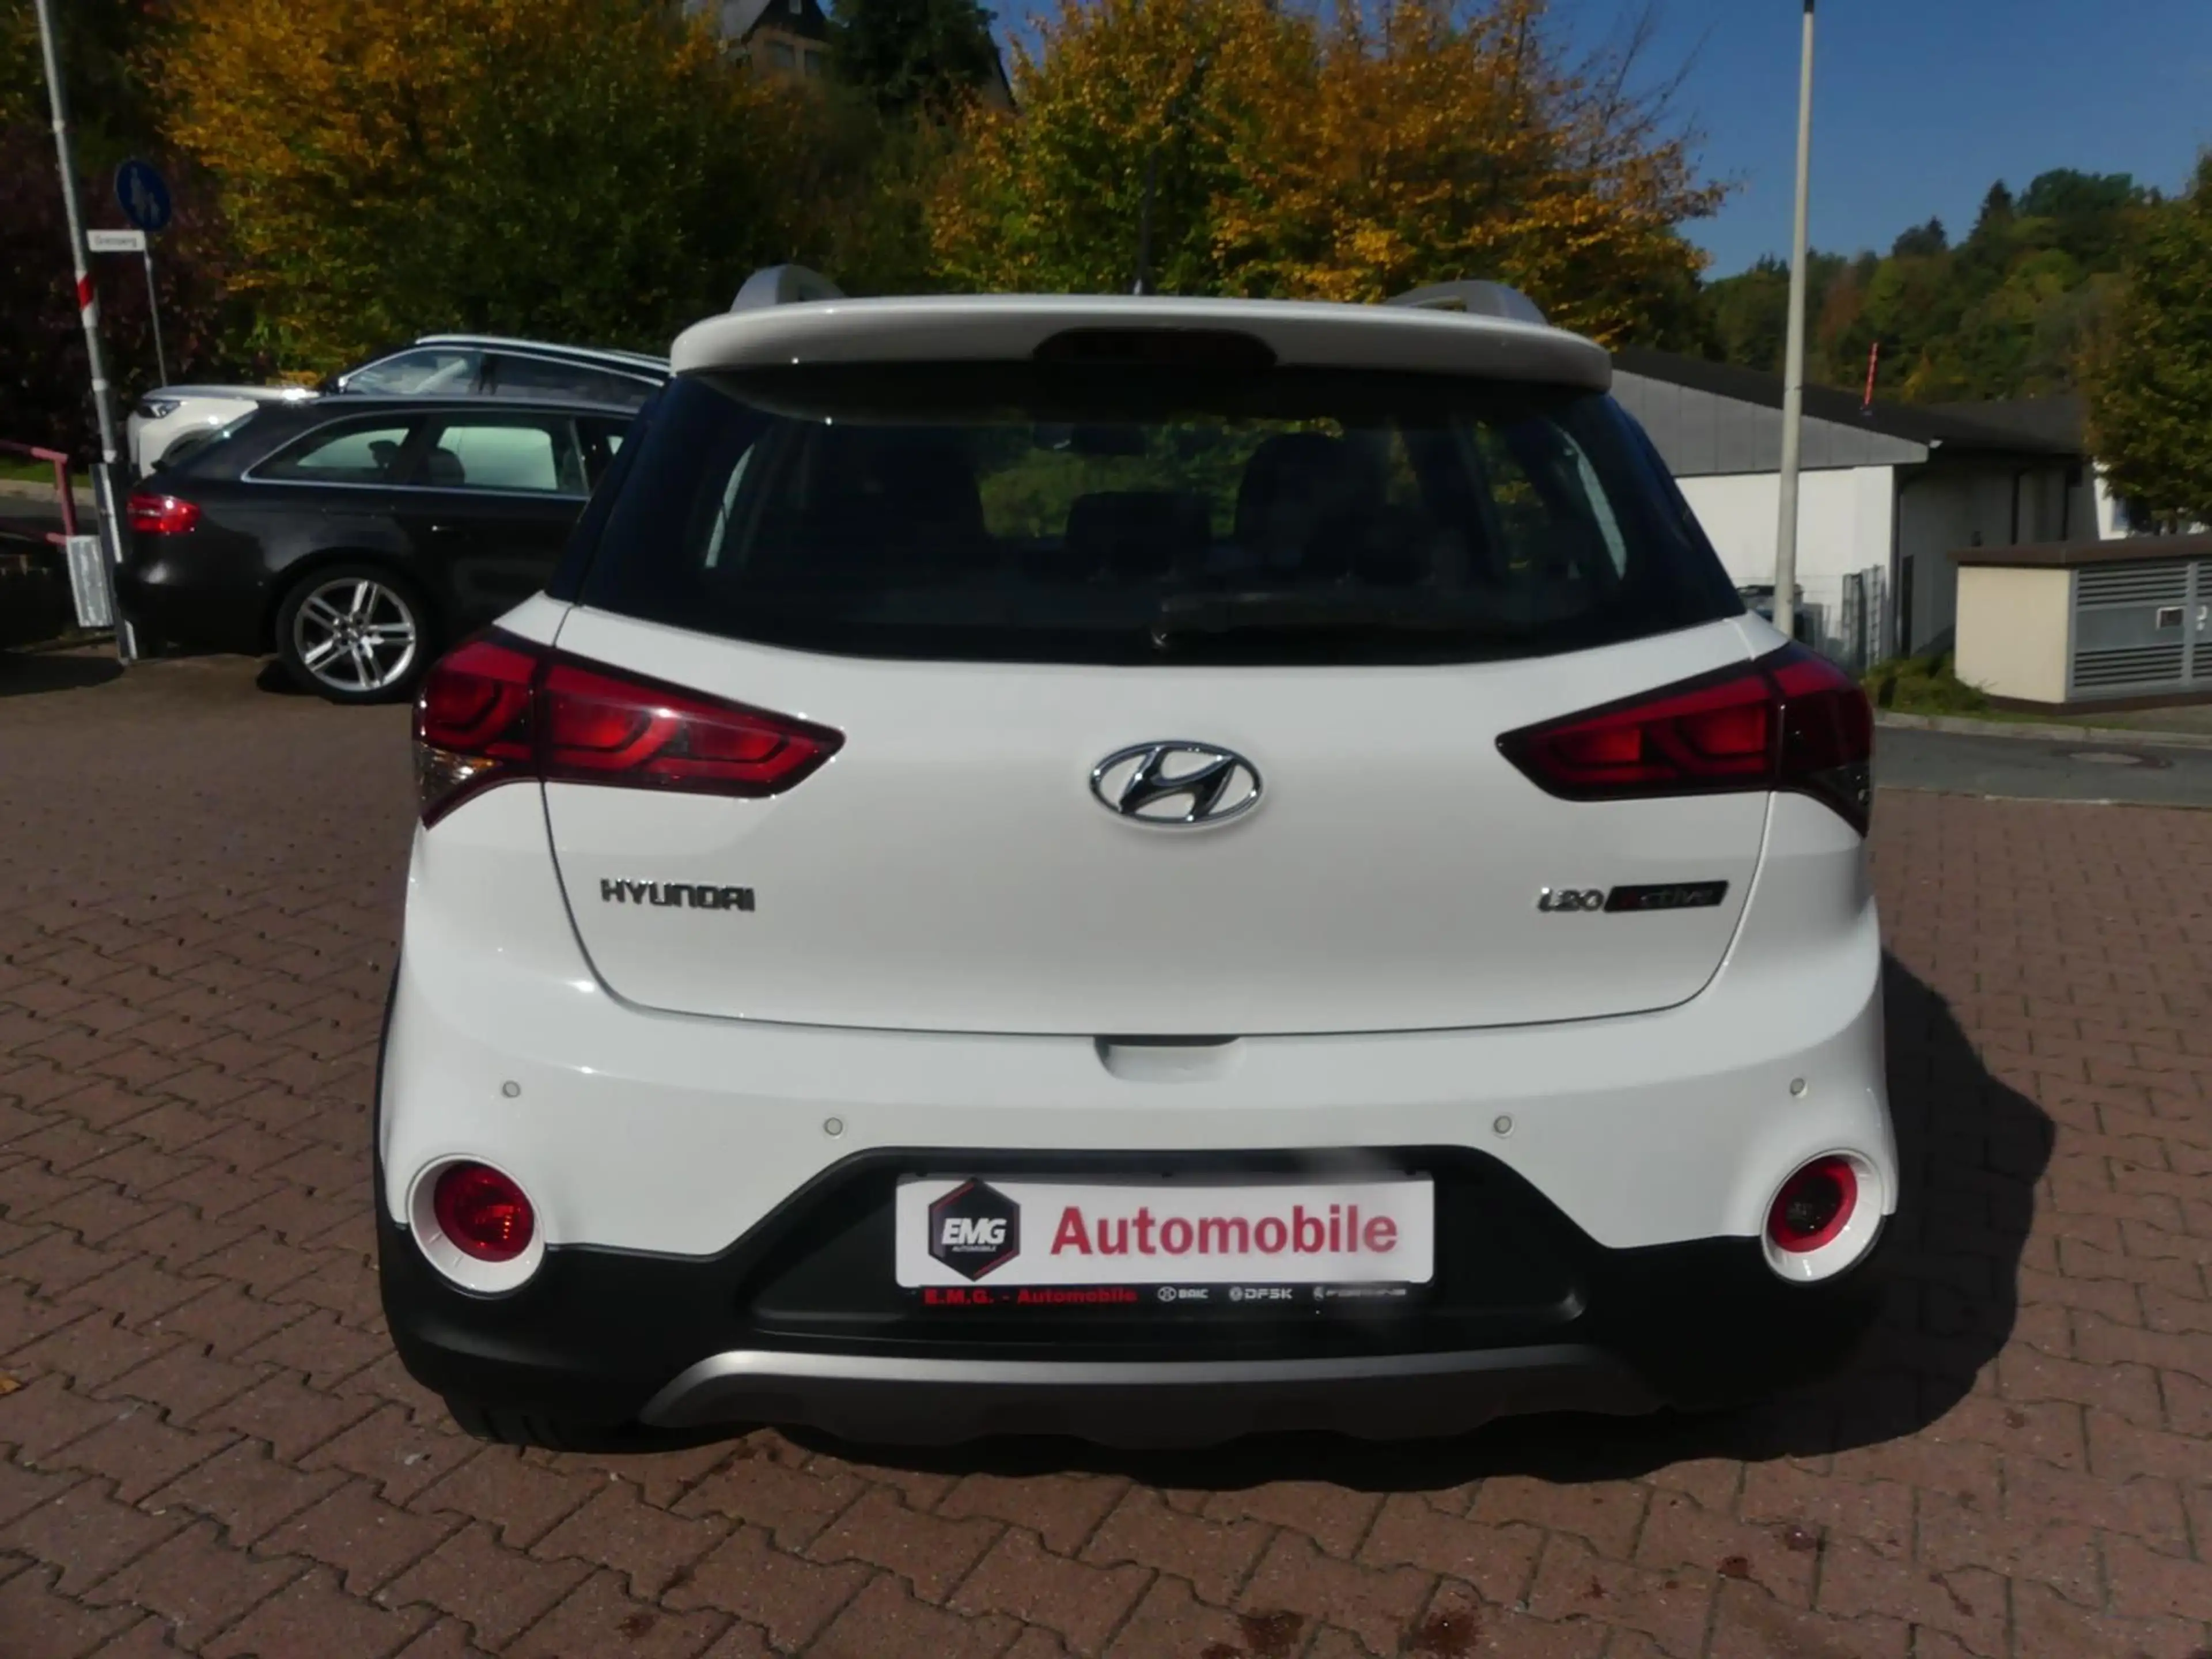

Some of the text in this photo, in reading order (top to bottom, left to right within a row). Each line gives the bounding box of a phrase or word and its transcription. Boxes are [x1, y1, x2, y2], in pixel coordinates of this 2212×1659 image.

[600, 878, 755, 912] HYUNDAI
[941, 1218, 1007, 1244] EMG
[1050, 1204, 1398, 1255] Automobile
[924, 1288, 994, 1305] E.M.G.
[1017, 1287, 1138, 1304] Automobile
[1178, 1288, 1209, 1299] BAIC
[1245, 1287, 1293, 1300] DFSK
